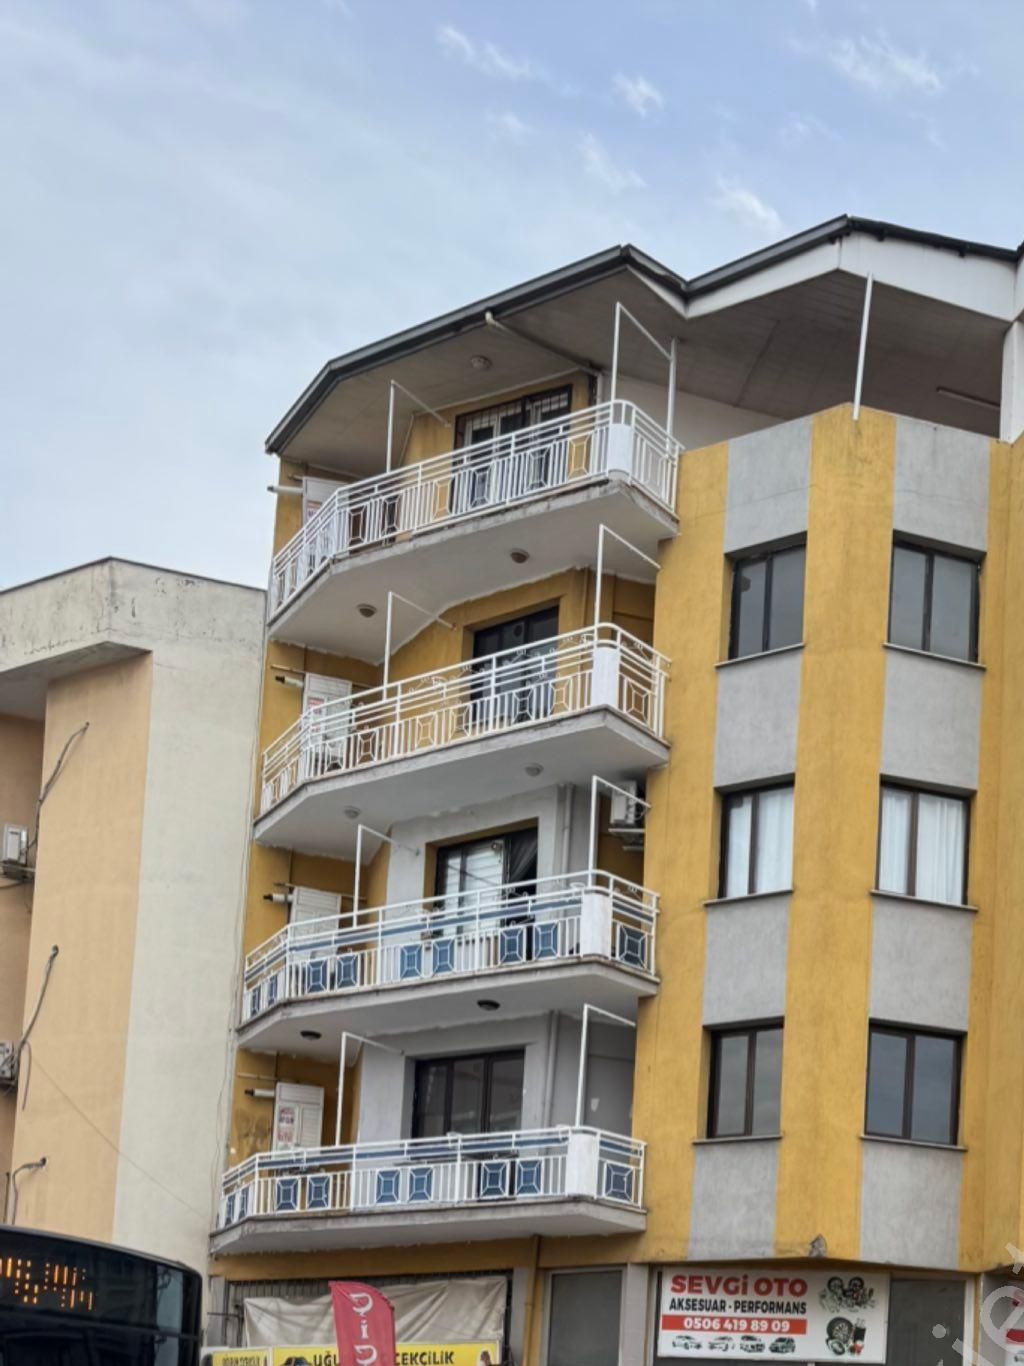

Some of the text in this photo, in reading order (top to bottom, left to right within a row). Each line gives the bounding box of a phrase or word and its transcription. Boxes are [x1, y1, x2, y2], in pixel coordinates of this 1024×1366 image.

[754, 1276, 808, 1297] OTO
[669, 1298, 726, 1312] AKSESUAR
[733, 1300, 807, 1315] PERFORMANS
[683, 1318, 790, 1333] 0506 419 89 09
